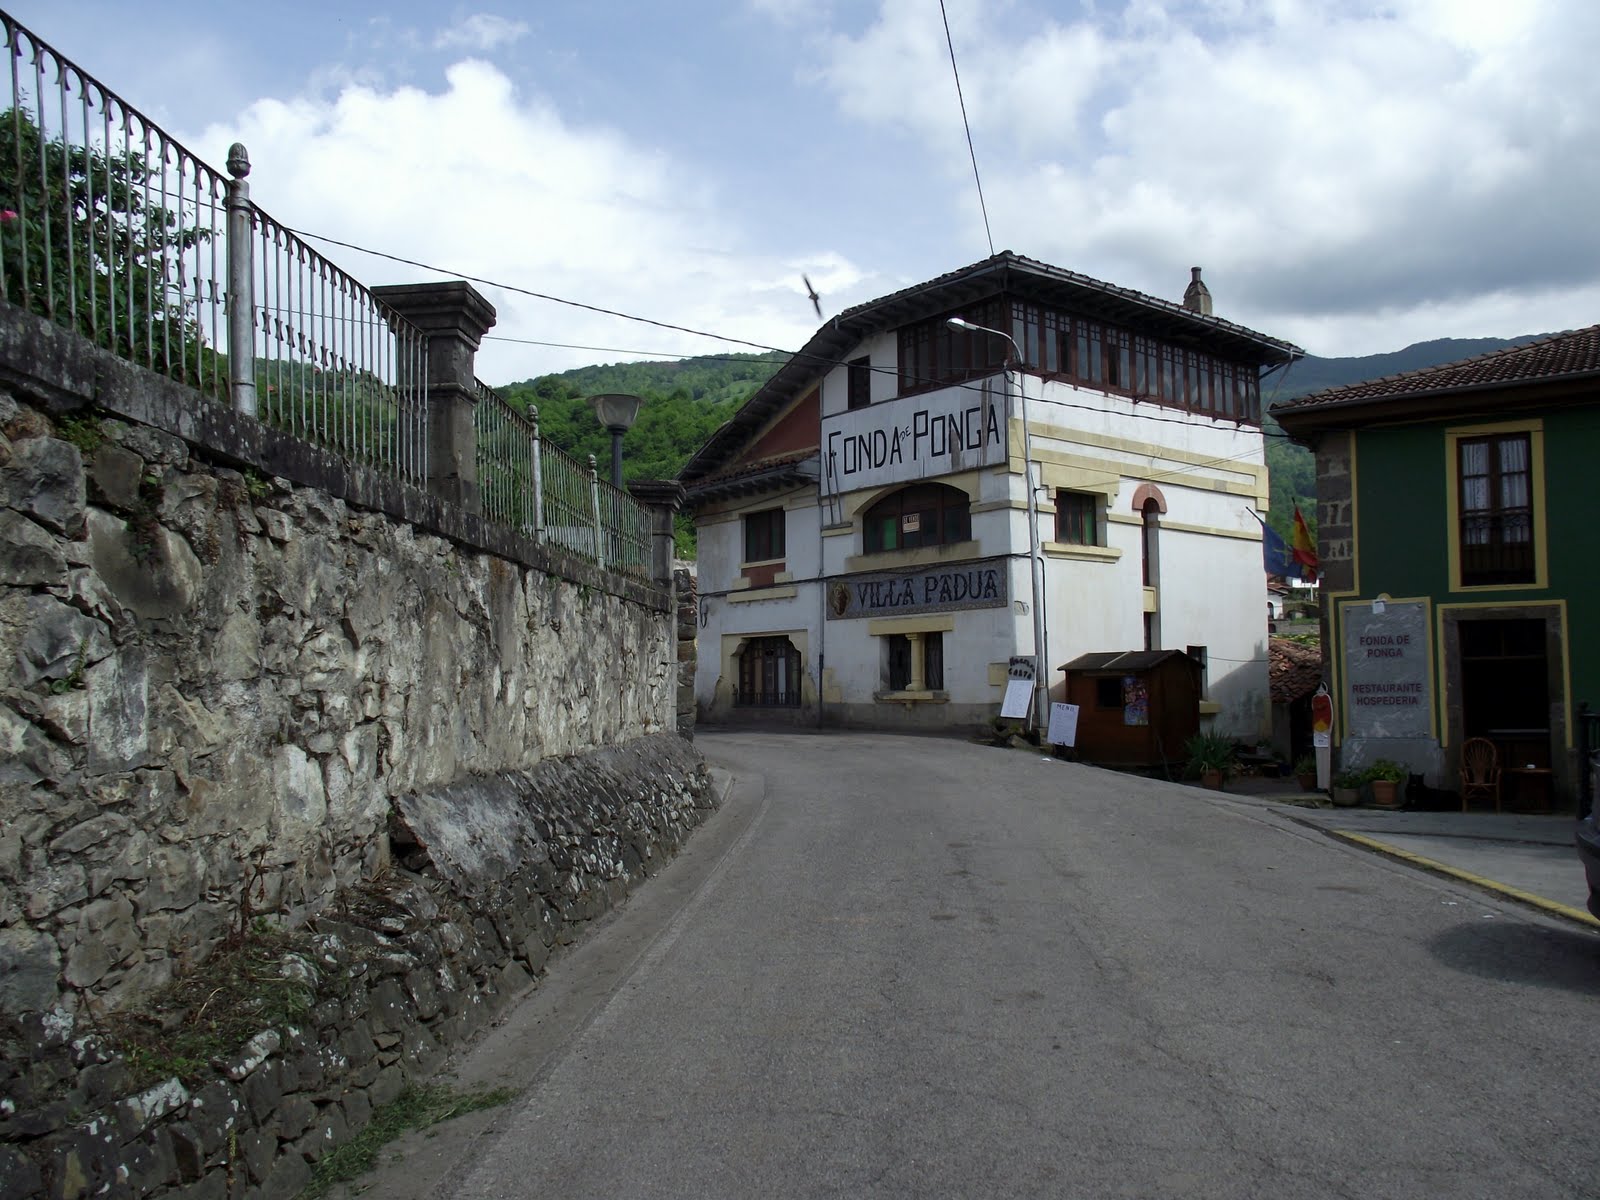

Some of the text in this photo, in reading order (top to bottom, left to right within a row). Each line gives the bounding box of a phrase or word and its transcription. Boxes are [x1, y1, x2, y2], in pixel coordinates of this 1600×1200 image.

[828, 404, 1000, 478] FONDA DE PONGA
[857, 570, 998, 608] VILLA PADUA
[1359, 635, 1410, 646] FONDA DE
[1367, 648, 1403, 658] PONGA
[1352, 683, 1422, 694] RESTAURANTE
[1356, 696, 1418, 706] HOSPEDERIA
